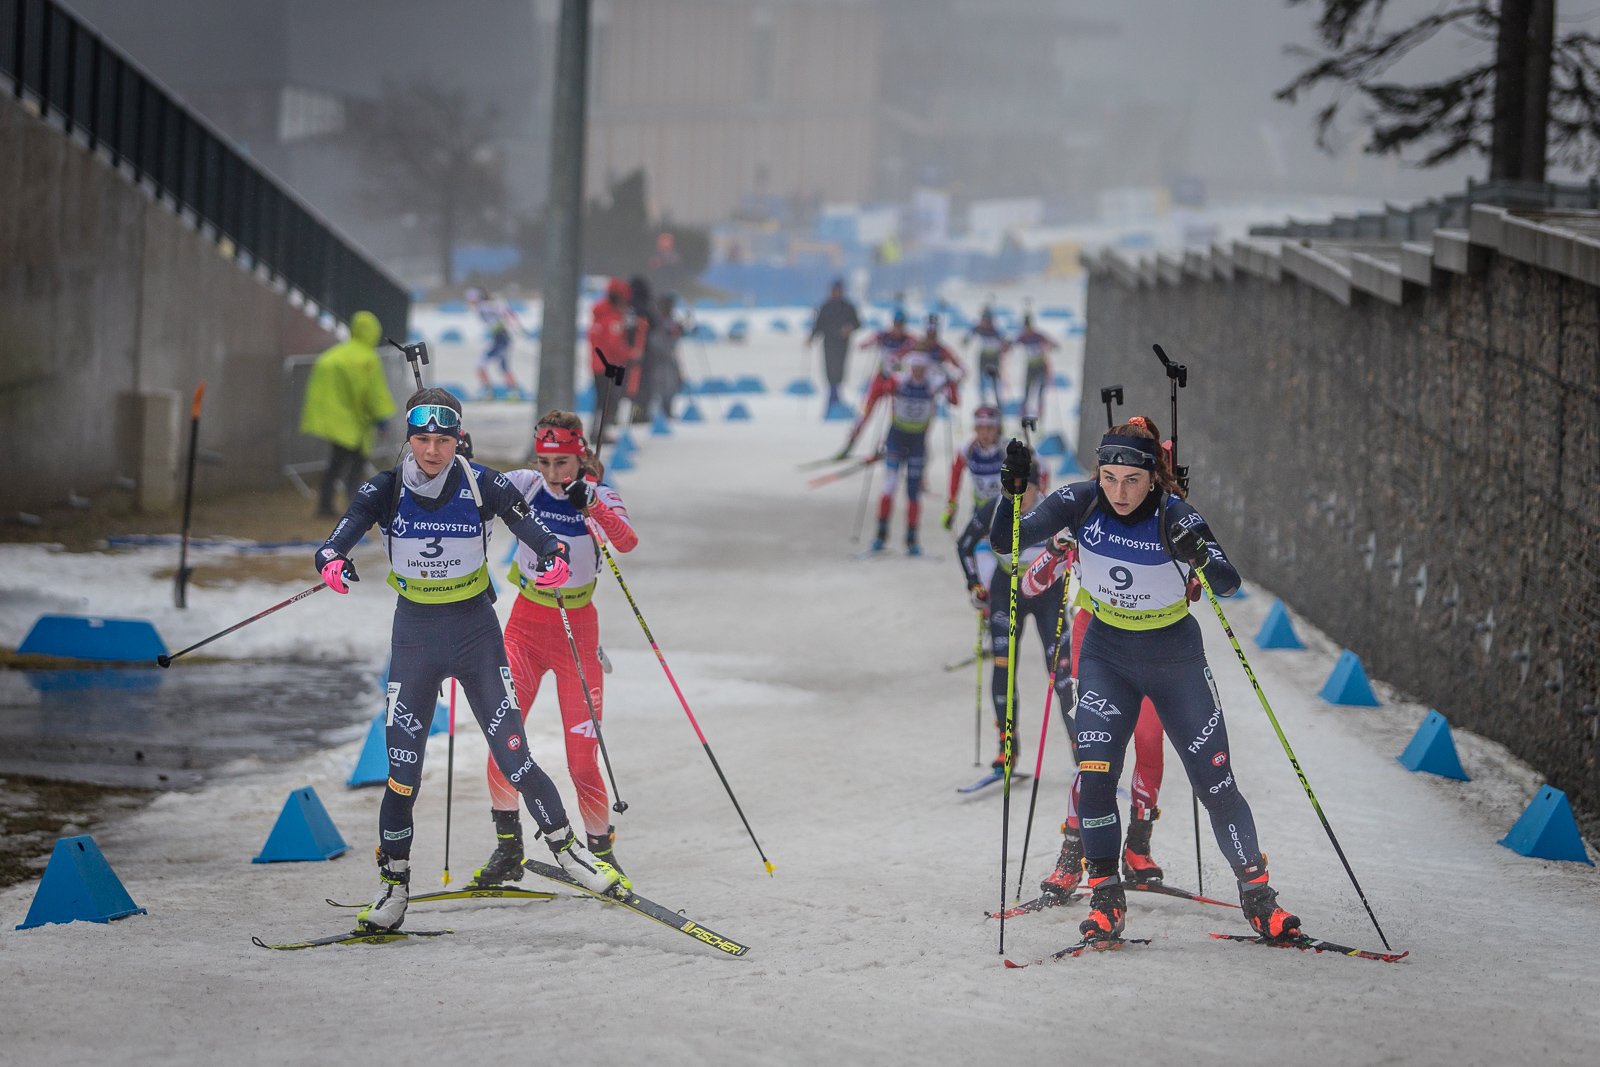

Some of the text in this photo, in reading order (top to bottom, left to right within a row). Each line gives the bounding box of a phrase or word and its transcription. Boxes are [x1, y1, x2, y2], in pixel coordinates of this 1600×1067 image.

[413, 520, 477, 533] KRYOSYSTEM
[418, 535, 445, 559] 3
[1108, 533, 1165, 551] KRYOSYSTE
[422, 585, 453, 593] OFFICIAL
[1108, 565, 1135, 591] 9
[1080, 689, 1122, 716] EA7
[689, 927, 741, 954] FISCHER
